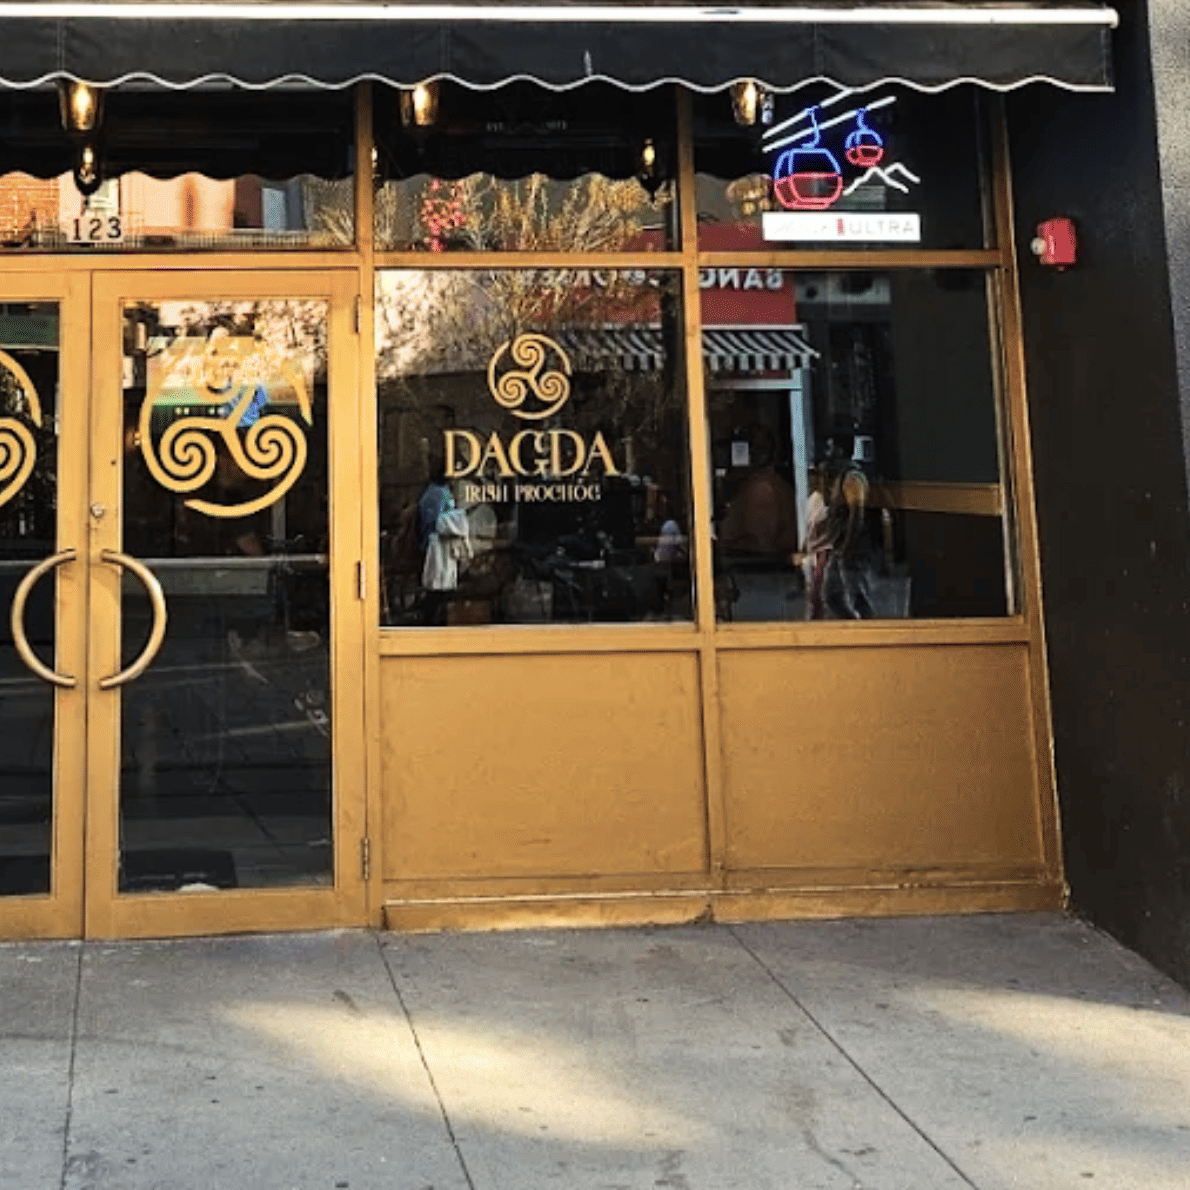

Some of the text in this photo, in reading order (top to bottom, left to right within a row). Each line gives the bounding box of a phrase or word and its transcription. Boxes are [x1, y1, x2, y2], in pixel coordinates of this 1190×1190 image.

[73, 216, 122, 240] 123
[849, 219, 915, 236] ULTRA
[442, 428, 622, 478] DAGDA
[465, 484, 508, 502] IRISH
